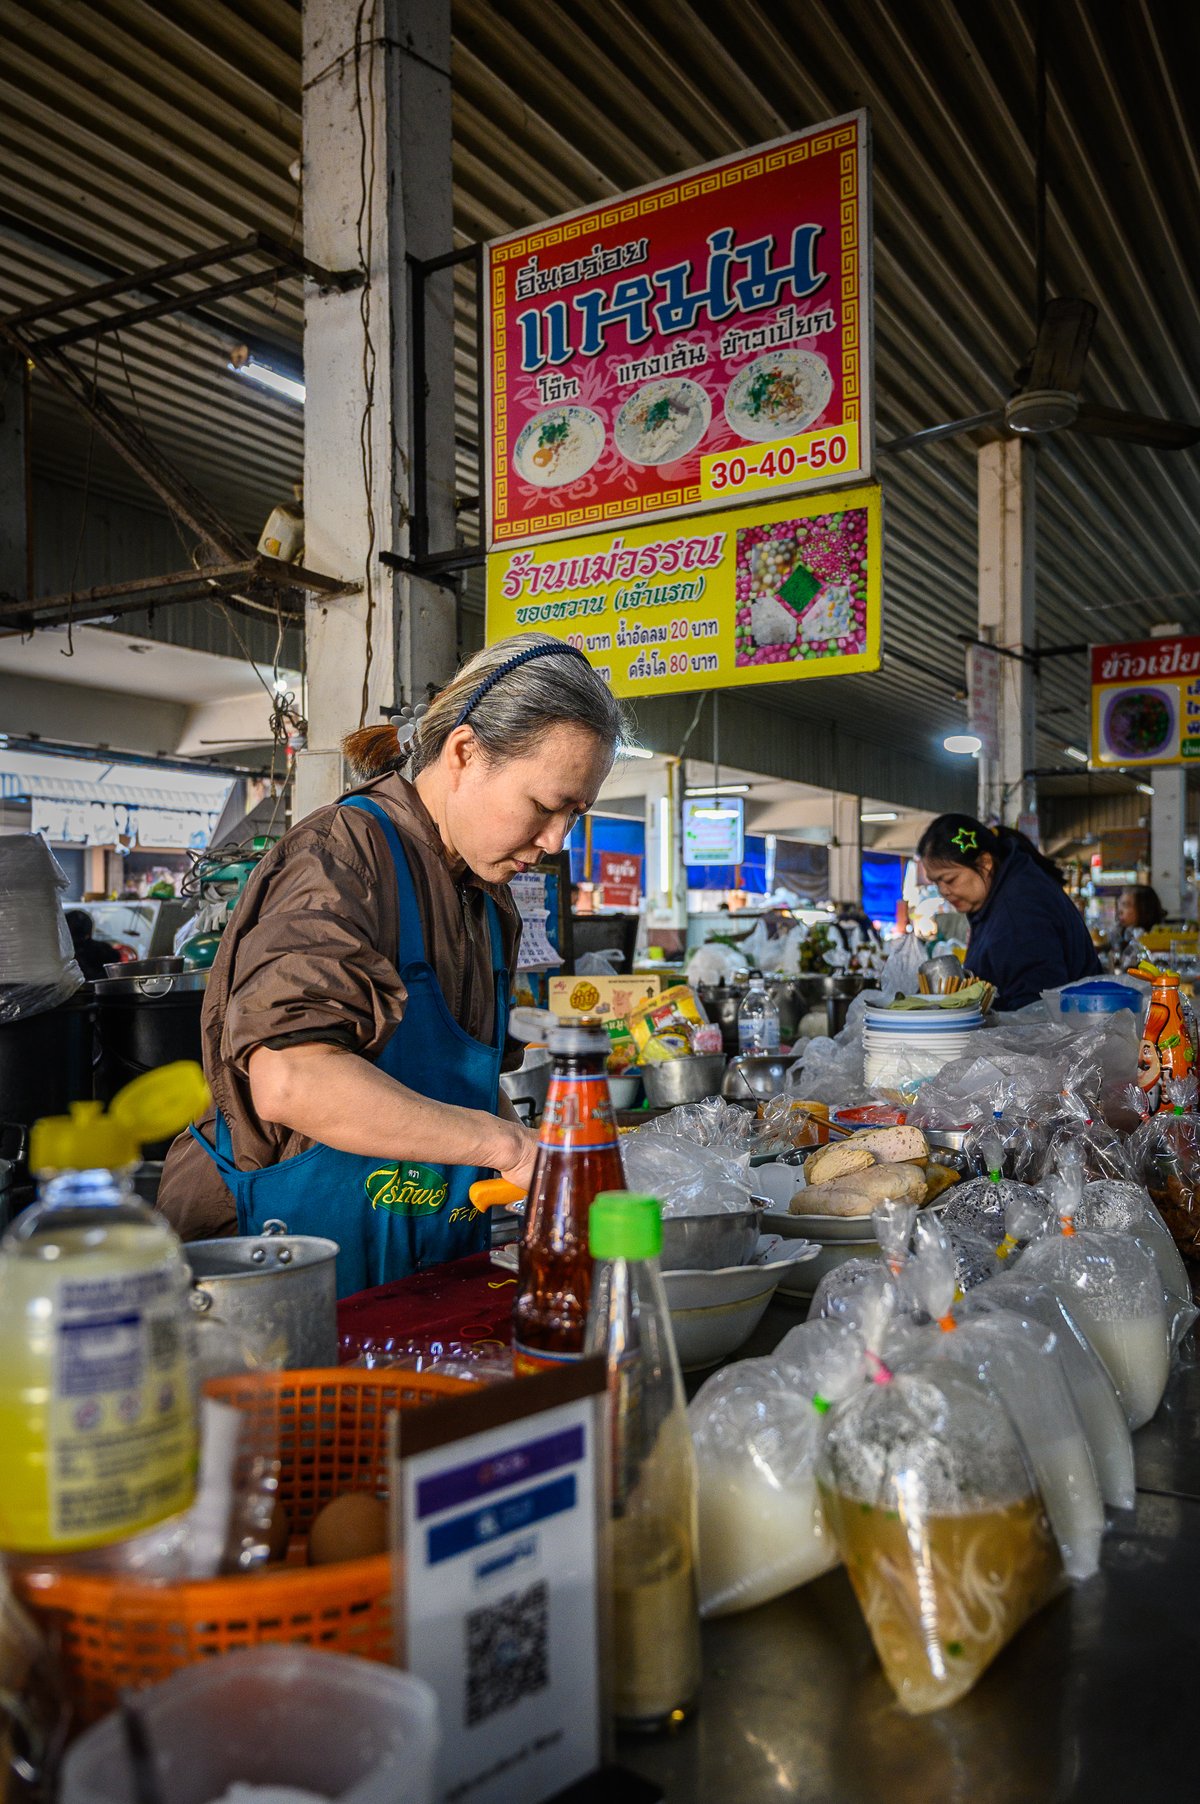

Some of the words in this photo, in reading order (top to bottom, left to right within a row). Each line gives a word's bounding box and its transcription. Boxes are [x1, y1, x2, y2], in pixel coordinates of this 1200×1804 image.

[516, 238, 648, 300] อิ่มอร่อย
[518, 224, 828, 371] แหม่ม
[721, 309, 836, 359] ข้าวเปียก
[617, 341, 706, 385] แกงเส้น
[537, 377, 579, 405] โจ๊ก
[710, 434, 848, 490] 30-40-50
[503, 533, 726, 598] ร้านแม่วรรณ
[515, 594, 605, 625] ของหวาน
[613, 576, 706, 613] (เจ้าแรก)
[586, 634, 611, 651] บาท
[616, 620, 667, 648] น้ำอัดลม
[670, 620, 688, 640] 20
[691, 620, 718, 637] บาท
[629, 650, 667, 679] ครึ่งโล
[670, 654, 688, 674] 80
[691, 655, 718, 671] บาท
